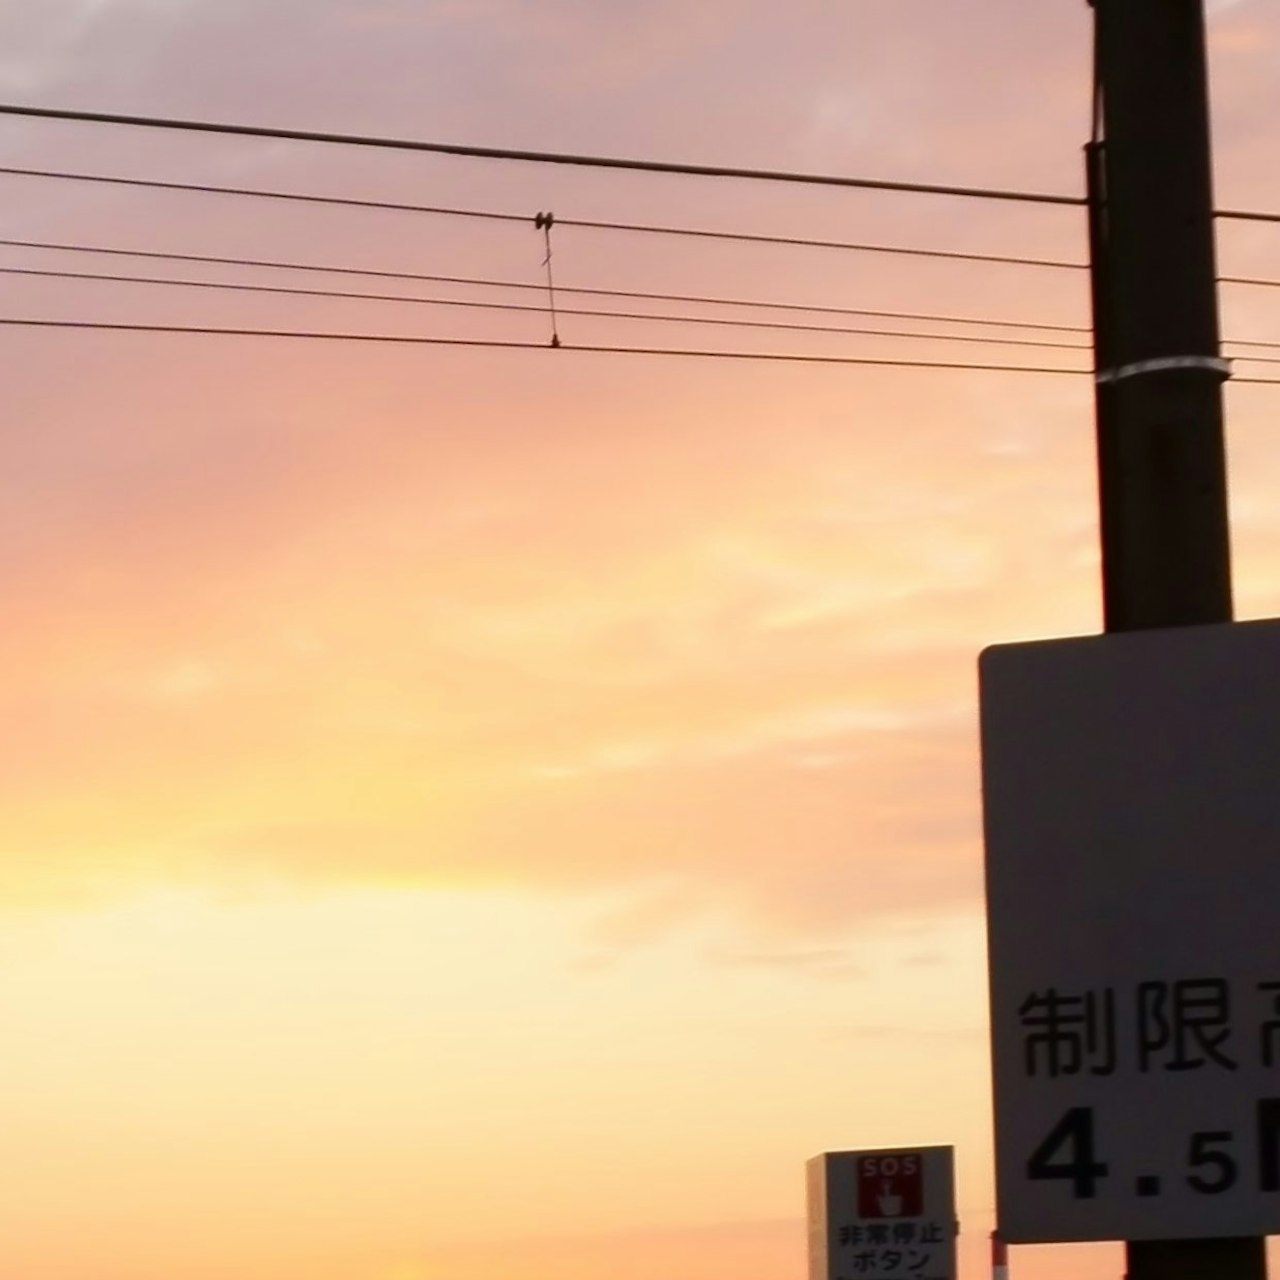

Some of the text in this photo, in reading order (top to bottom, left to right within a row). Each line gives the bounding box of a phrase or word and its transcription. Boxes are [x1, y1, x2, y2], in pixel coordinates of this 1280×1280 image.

[1018, 977, 1280, 1079] 制限
[1026, 1098, 1280, 1200] 4.5
[862, 1156, 917, 1177] SOS
[839, 1222, 945, 1247] 非常停止
[852, 1249, 930, 1272] ボタン
